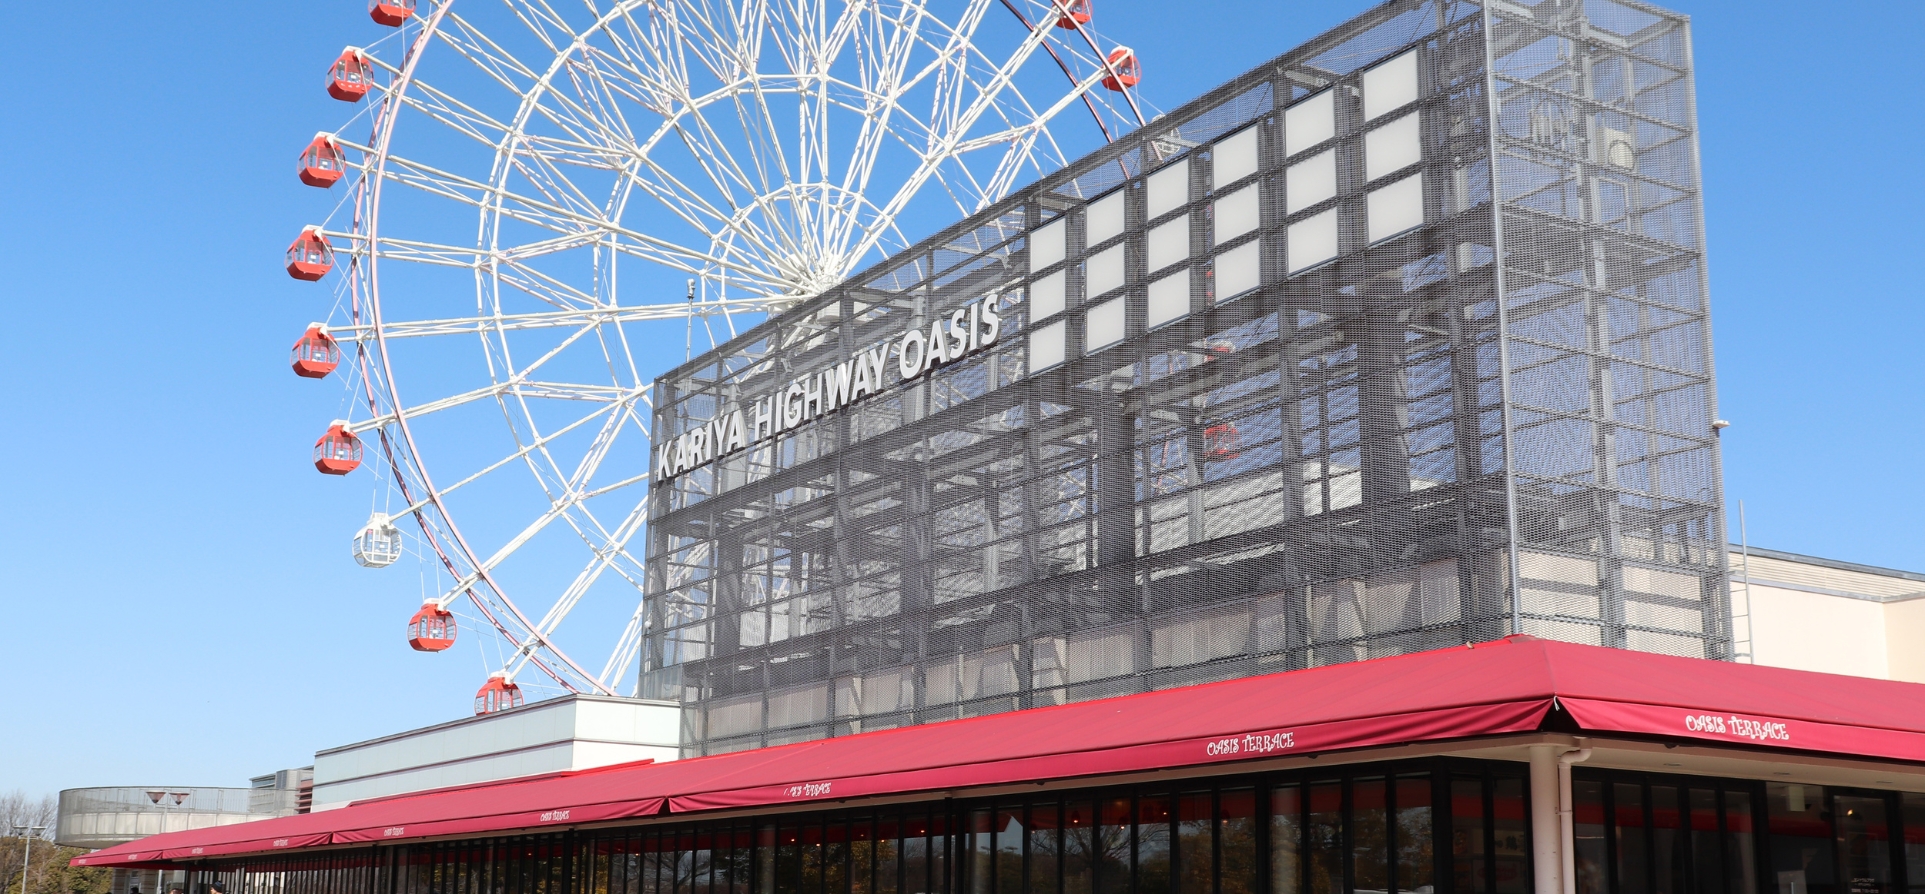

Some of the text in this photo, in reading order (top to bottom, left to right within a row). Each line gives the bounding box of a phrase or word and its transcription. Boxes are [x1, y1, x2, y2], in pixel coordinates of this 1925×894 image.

[657, 294, 1000, 481] KARIYA HIGHWAY OASIS
[1685, 715, 1790, 741] OASIS TERRACE
[1206, 732, 1295, 756] OASIS TERRACE
